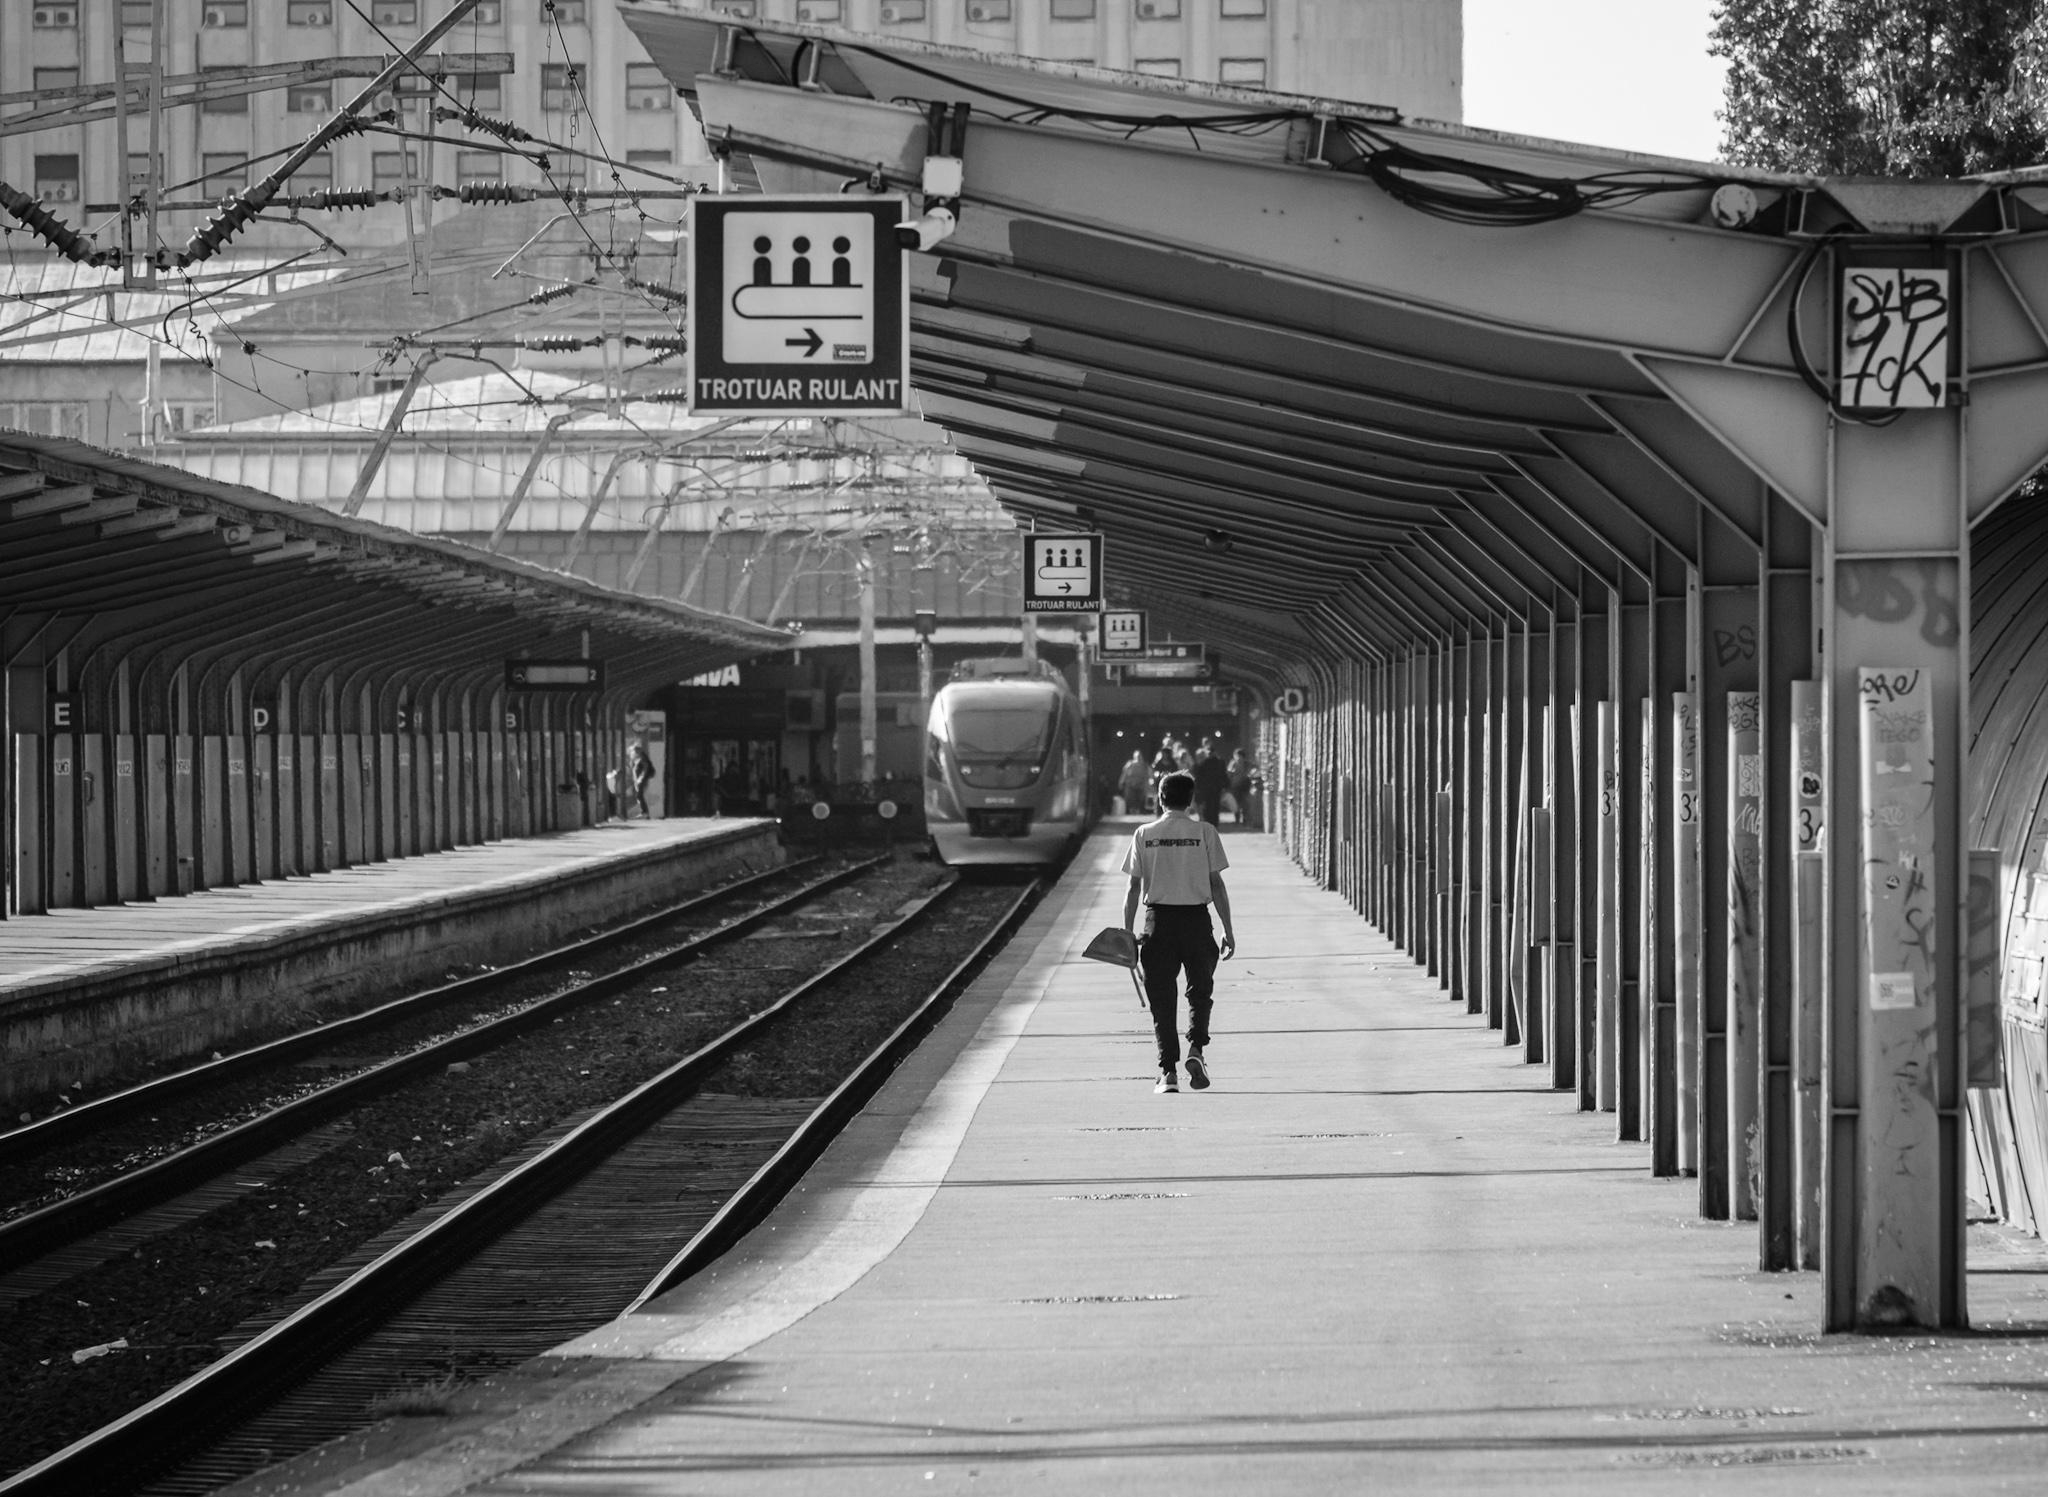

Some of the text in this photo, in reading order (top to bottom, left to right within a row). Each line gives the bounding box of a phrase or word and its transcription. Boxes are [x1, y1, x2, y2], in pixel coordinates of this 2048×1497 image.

[697, 378, 900, 400] TROTUAR RULANT
[1026, 600, 1099, 610] TROTUAR RULANT
[1284, 688, 1304, 712] D
[54, 702, 70, 726] E
[254, 708, 269, 728] D
[1145, 838, 1201, 848] ROMPREST
